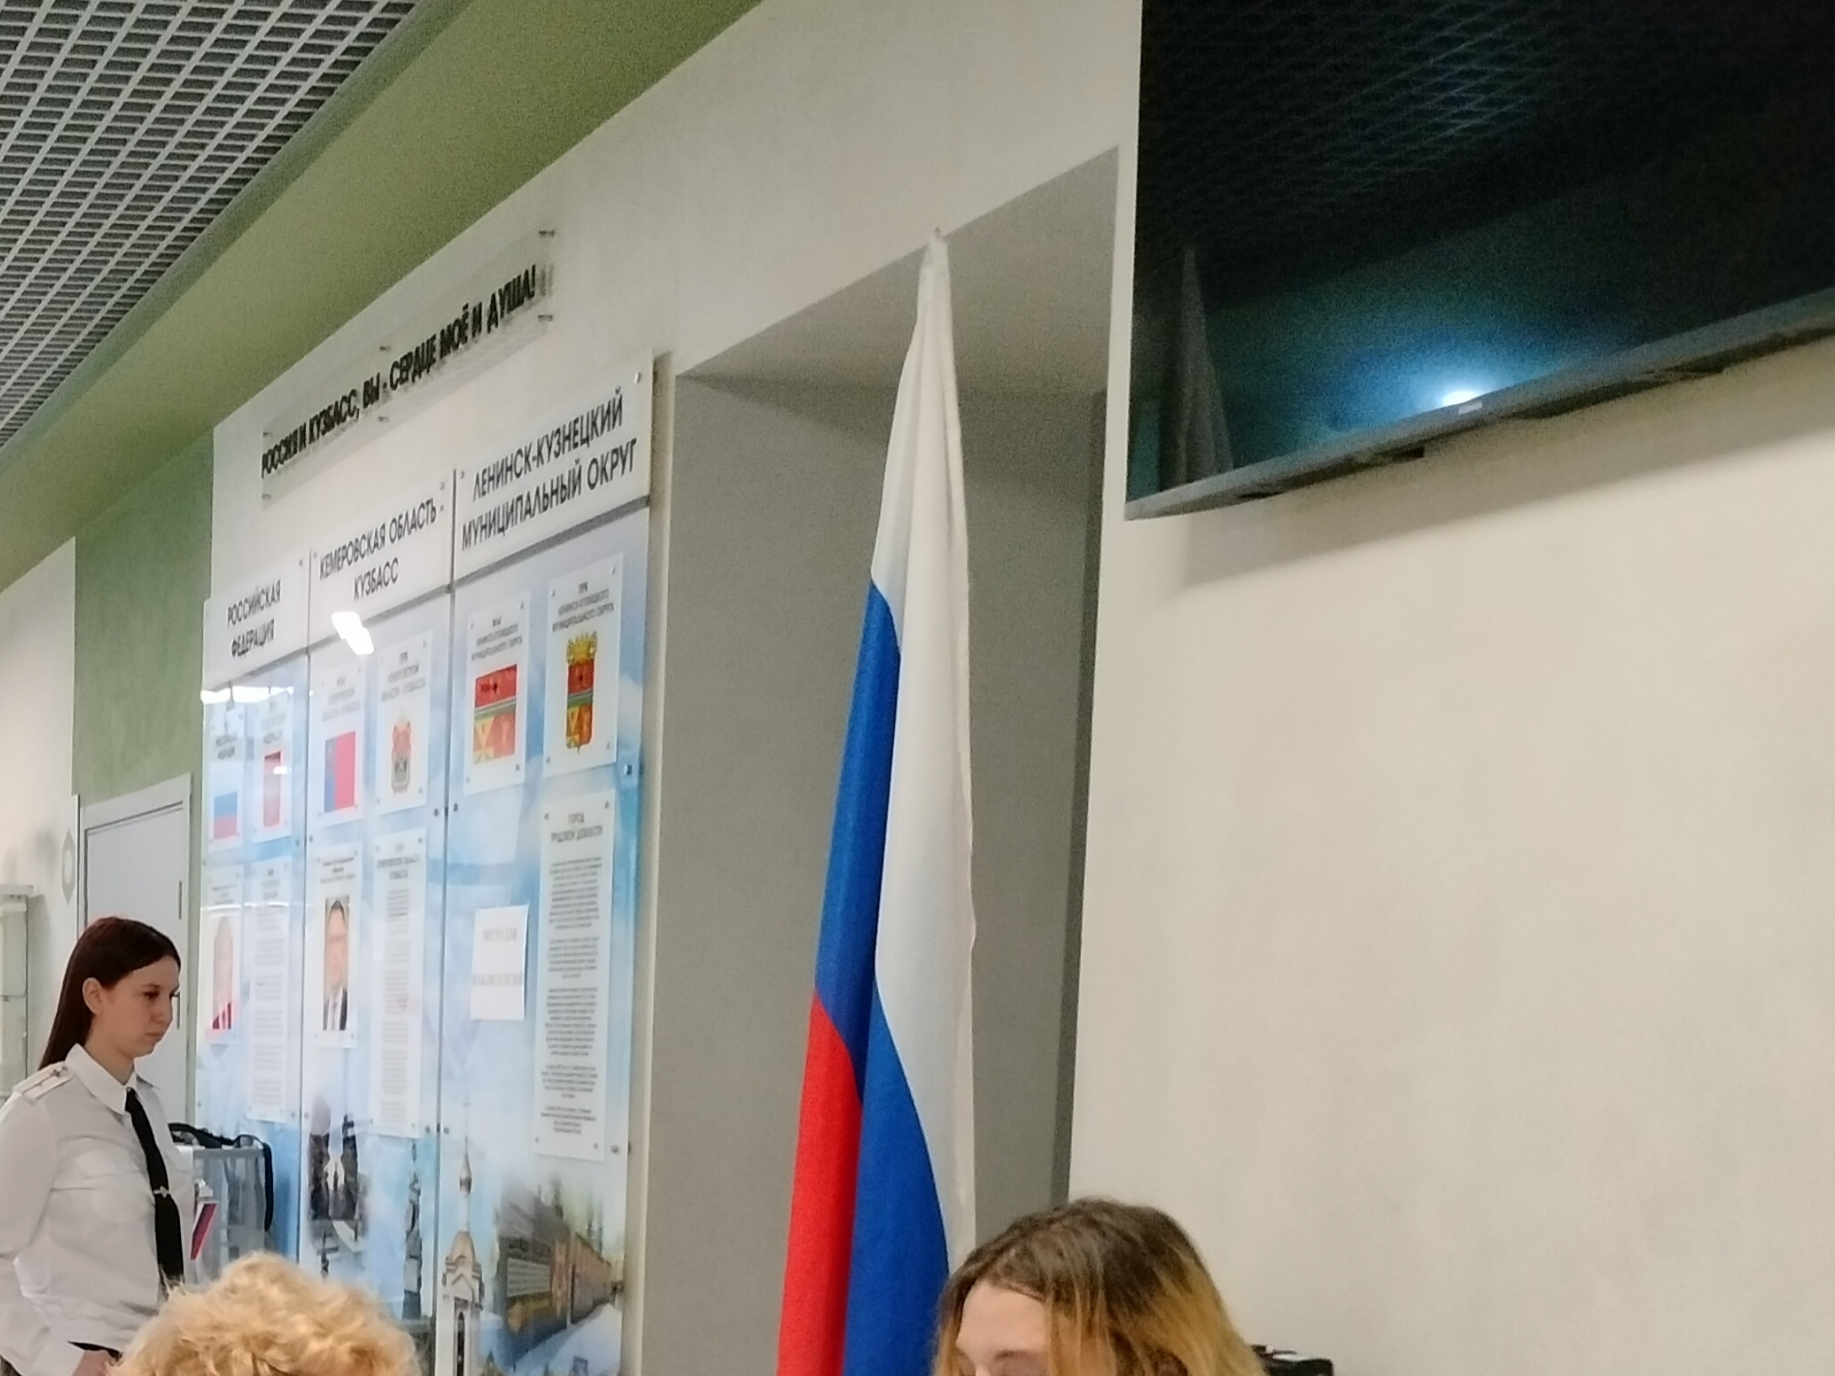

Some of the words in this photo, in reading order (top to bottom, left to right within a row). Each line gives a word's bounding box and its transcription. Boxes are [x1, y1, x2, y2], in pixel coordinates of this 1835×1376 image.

[261, 429, 298, 479] РОССИЯ
[299, 423, 306, 452] И
[309, 389, 359, 444] КУЗБАСС,
[363, 373, 380, 409] ВЫ
[390, 334, 436, 390] СЕРДЦЕ
[439, 303, 469, 360] МОЁ
[472, 302, 482, 339] И
[487, 265, 535, 334] ДУША!
[473, 387, 623, 501] ЛЕНИНСК-КУЗНЕЦКИЙ
[462, 458, 582, 551] МУНИЦИПАЛЬНЫЙ
[587, 438, 637, 490] ОКРУГ
[320, 521, 386, 581] КЕМЕРОВСКАЯ
[389, 498, 436, 543] ОБЛАСТЬ
[354, 557, 399, 601] КУЗБАСС
[227, 580, 281, 627] РОССИЙСКАЯ
[231, 619, 274, 657] ФЕДЕРАЦИЯ
